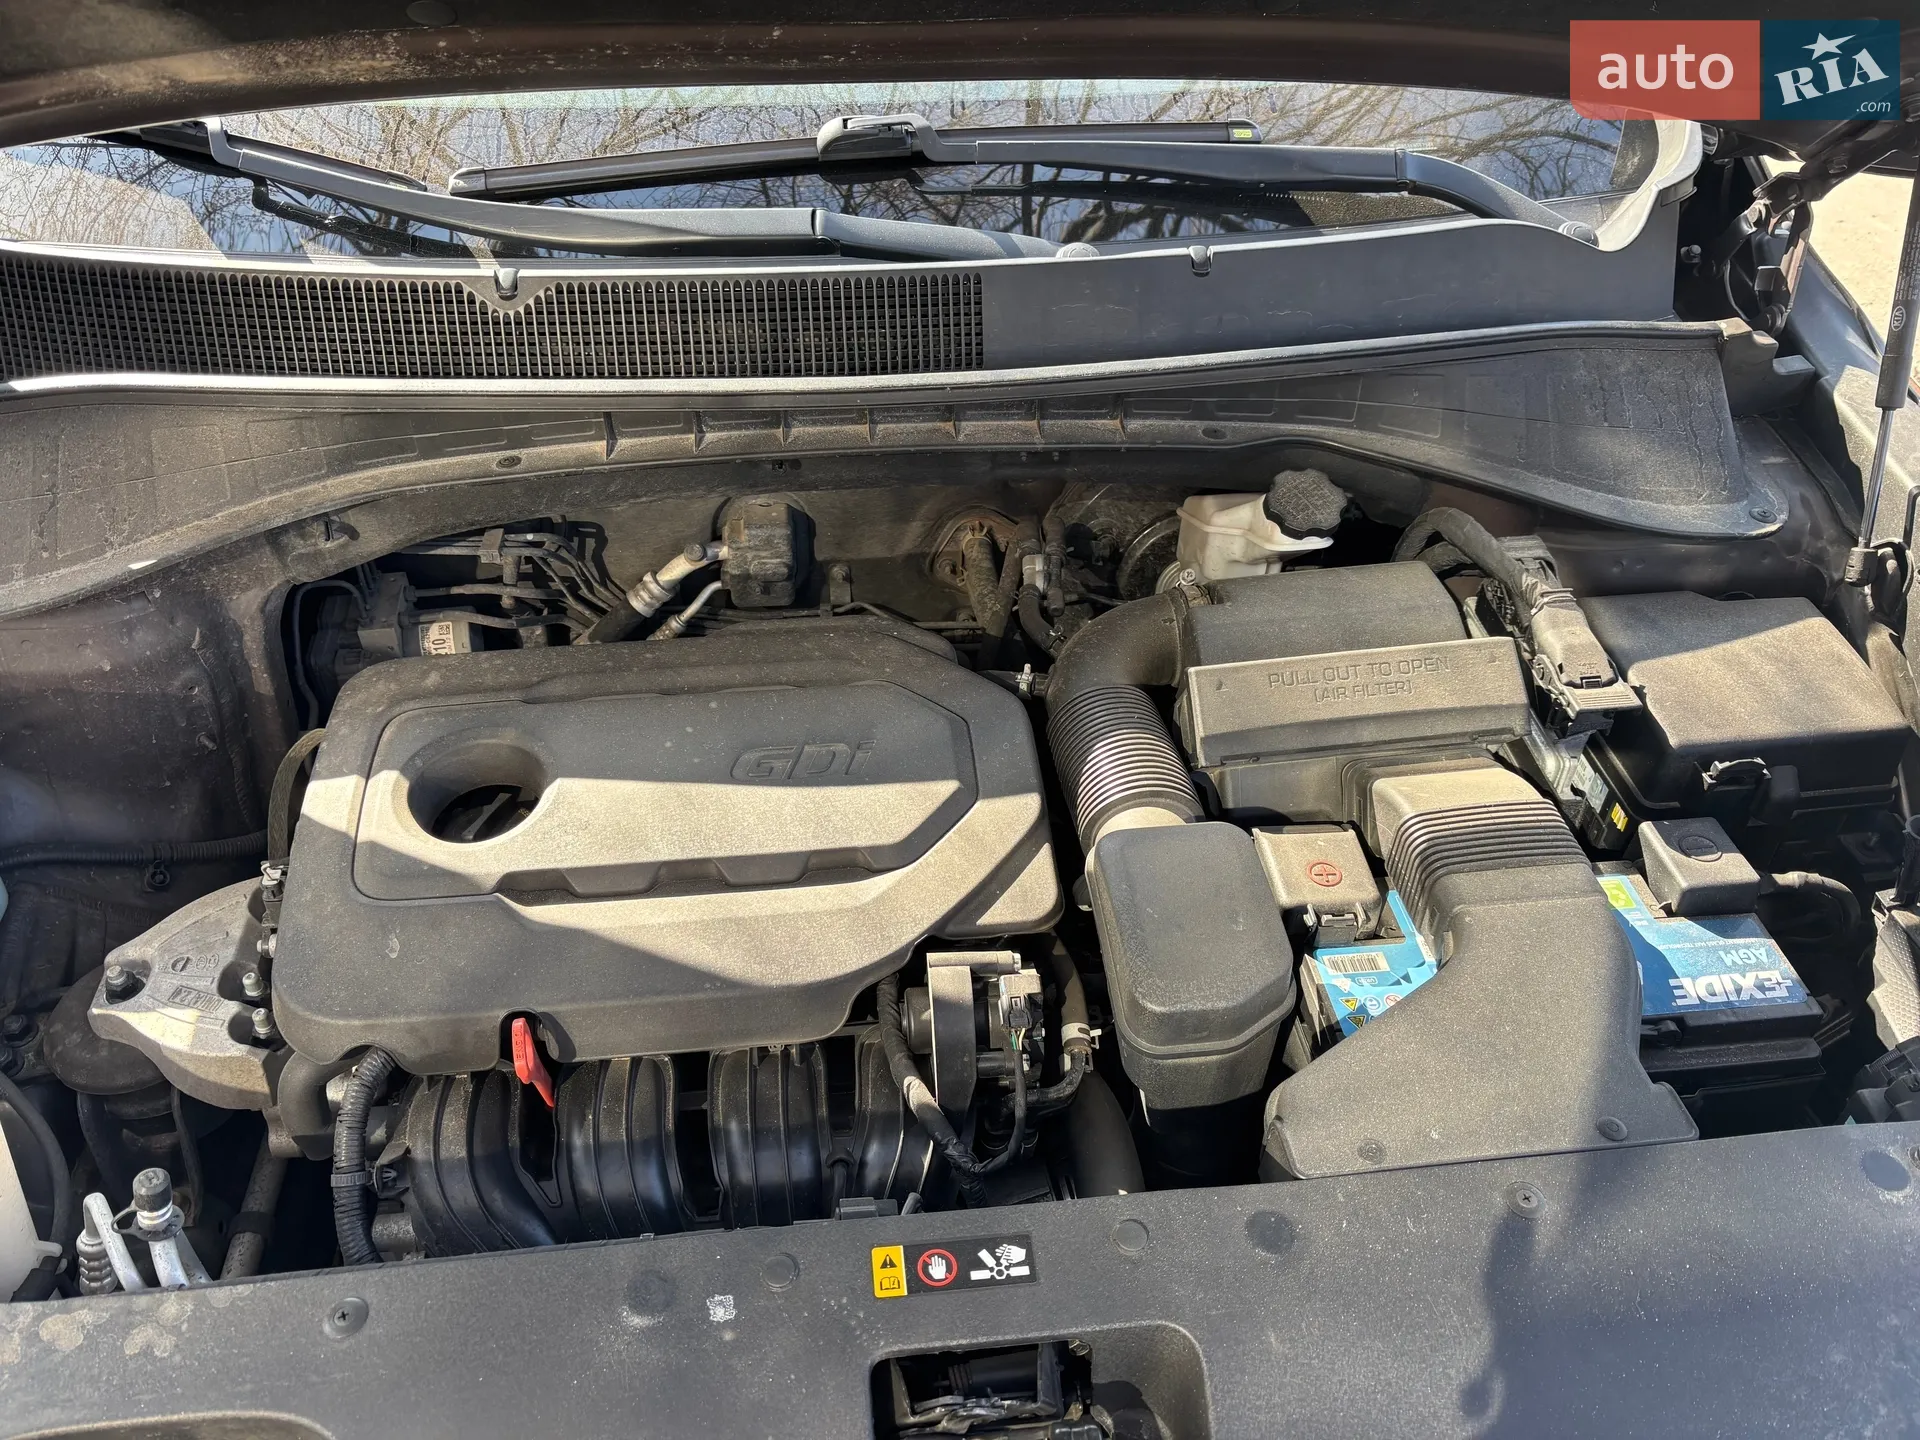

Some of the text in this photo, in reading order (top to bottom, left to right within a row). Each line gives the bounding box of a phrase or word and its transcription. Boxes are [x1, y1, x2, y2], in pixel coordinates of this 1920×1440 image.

[1267, 656, 1451, 689] PULL OUT TO OPEN
[730, 740, 877, 782] GDi
[1718, 948, 1769, 966] AGM
[1668, 970, 1793, 1005] EXIDE
[515, 1040, 525, 1060] ENG
